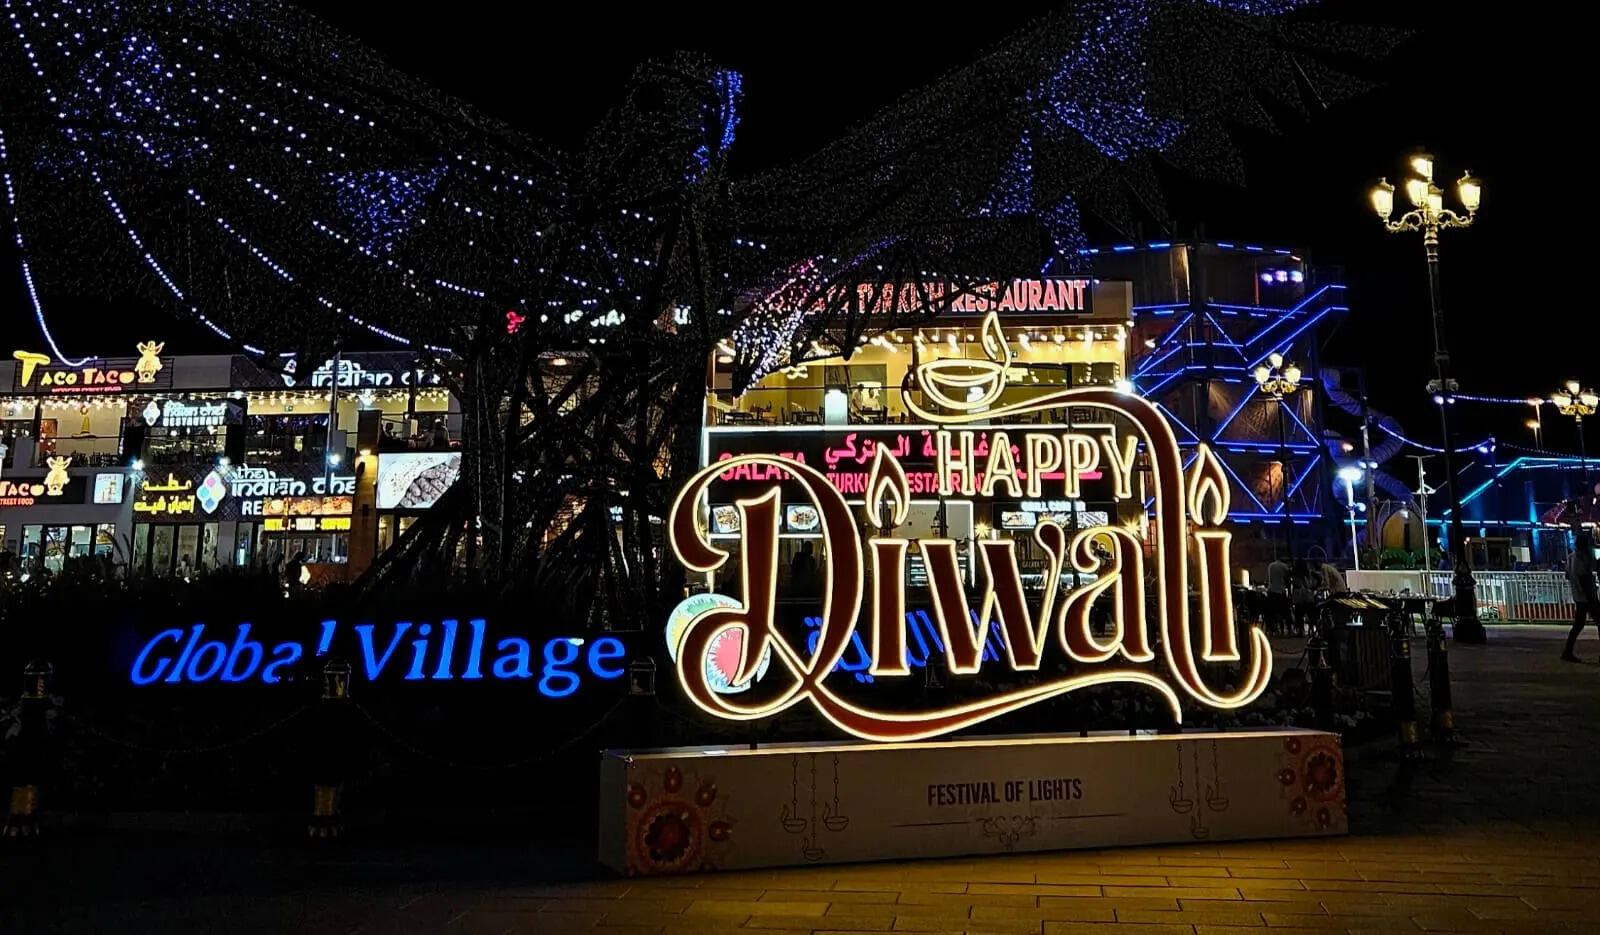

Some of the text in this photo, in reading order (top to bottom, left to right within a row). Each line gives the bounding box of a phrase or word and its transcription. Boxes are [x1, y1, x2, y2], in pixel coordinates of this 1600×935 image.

[231, 466, 306, 496] indian
[826, 471, 869, 493] TURKI
[936, 430, 1138, 498] HAPPY
[667, 390, 1273, 743] Diwali
[354, 618, 626, 699] Village
[927, 778, 1082, 806] FESTIVAL OF LIGHTS
